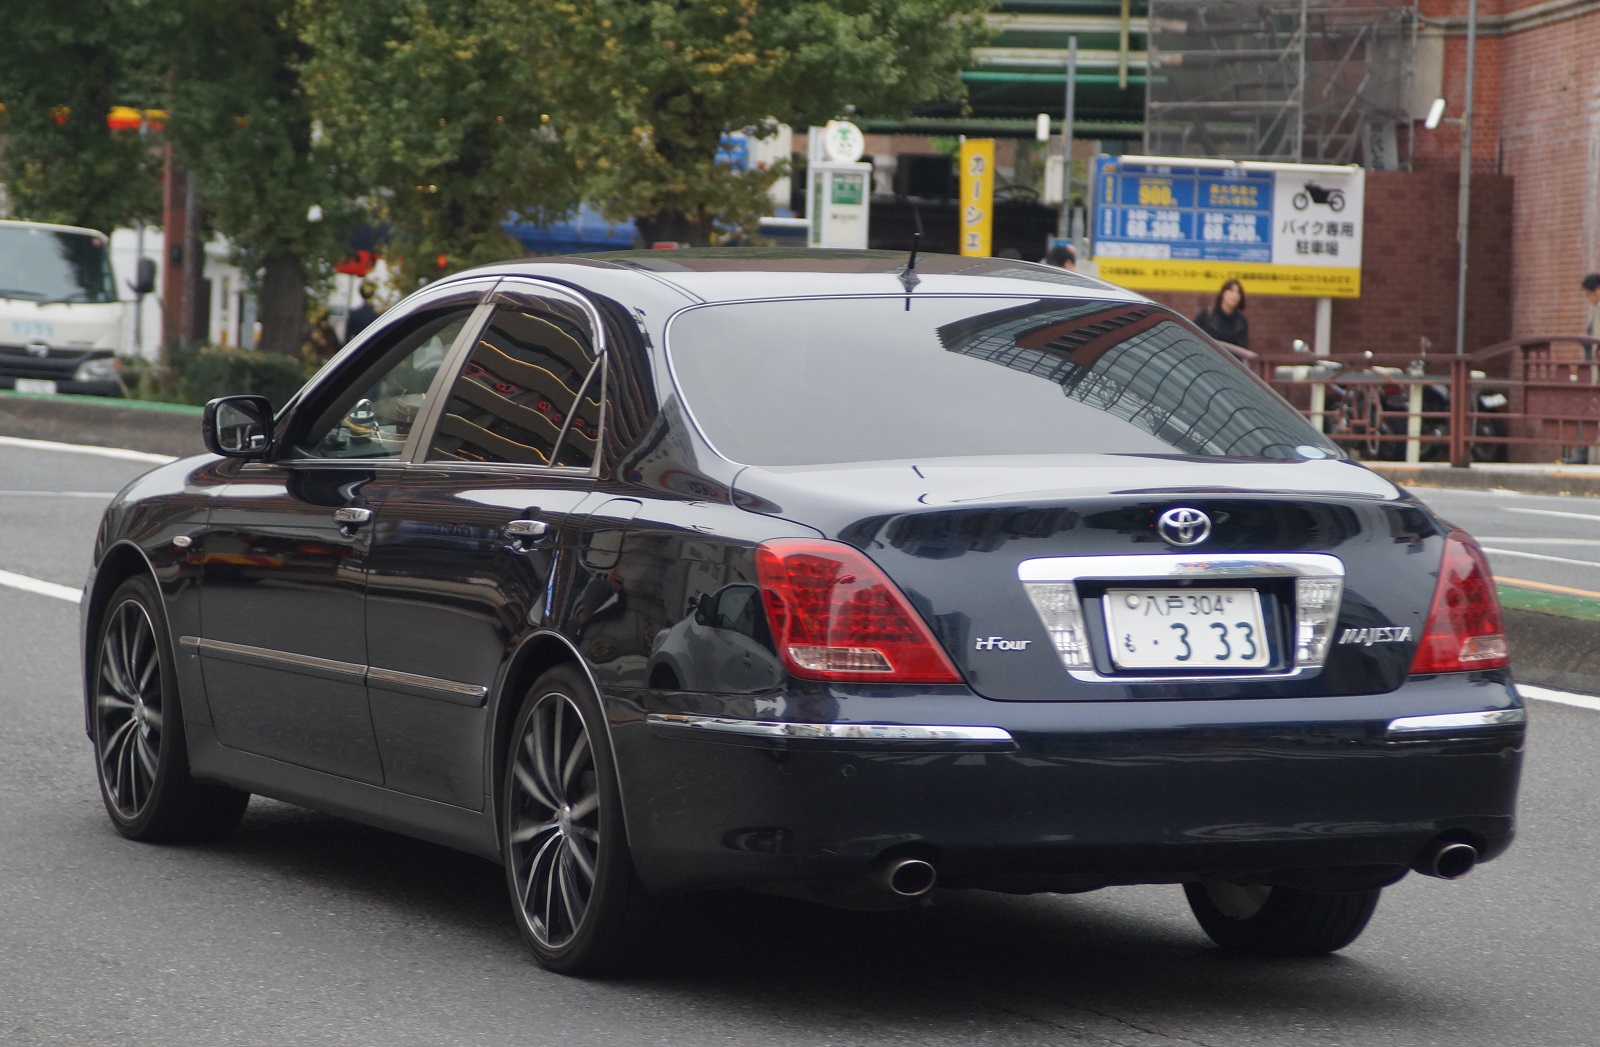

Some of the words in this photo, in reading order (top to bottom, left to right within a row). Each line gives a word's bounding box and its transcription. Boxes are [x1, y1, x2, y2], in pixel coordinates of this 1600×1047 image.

[1281, 219, 1355, 238] バイク専用
[1296, 239, 1339, 257] 駐車場
[1338, 626, 1412, 646] MAJESTA
